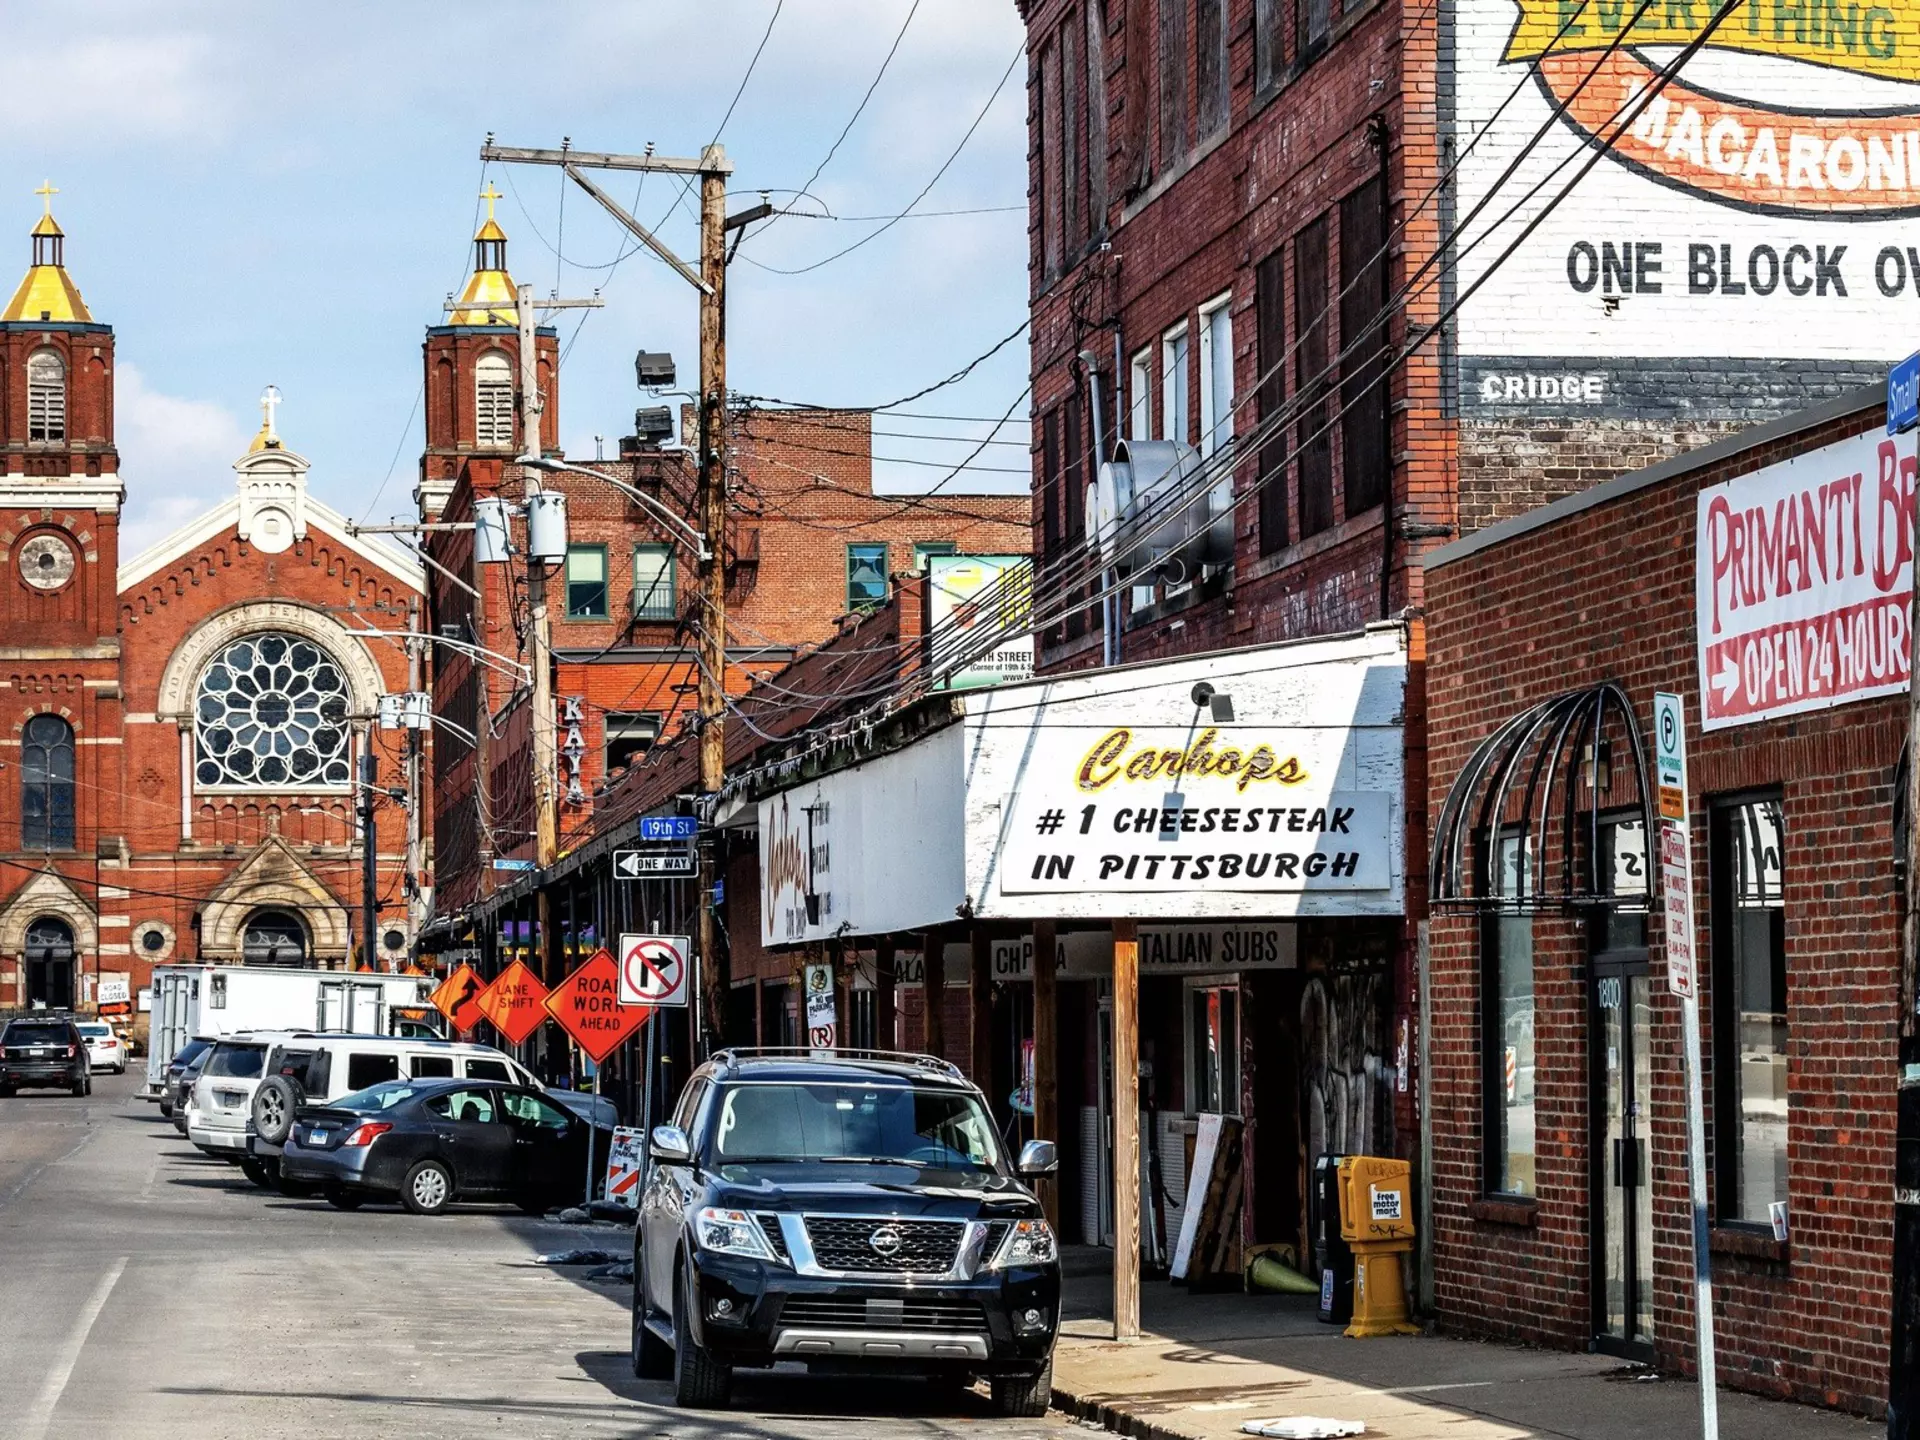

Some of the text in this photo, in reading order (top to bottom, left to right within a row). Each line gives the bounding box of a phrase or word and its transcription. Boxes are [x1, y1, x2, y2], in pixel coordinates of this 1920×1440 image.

[1566, 241, 1662, 293] ONE
[1688, 243, 1849, 298] BLOCK
[1482, 373, 1604, 401] CRIDGE
[1707, 473, 1863, 634] PRIMANTI
[997, 651, 1033, 662] STREET
[1744, 627, 1801, 706] OPEN
[1807, 617, 1834, 693] 24
[563, 695, 586, 804] KAYA
[1075, 727, 1309, 793] Carhops
[647, 820, 690, 835] 19th St
[1113, 806, 1355, 834] CHEESESTEAK
[637, 858, 687, 870] ONE WAY
[1031, 851, 1360, 880] IN PITTSBURGH
[1138, 930, 1278, 963] TALIAN SUBS
[104, 983, 122, 992] ROAD
[497, 984, 529, 996] LANE
[1598, 978, 1621, 1008] 1800
[100, 992, 127, 1001] CLOSED
[500, 997, 535, 1009] SHIFT
[574, 996, 625, 1013] WORK
[579, 1016, 620, 1031] AHEAD
[1373, 1200, 1399, 1208] motor
[1377, 1193, 1395, 1201] free
[1376, 1207, 1397, 1215] mart
